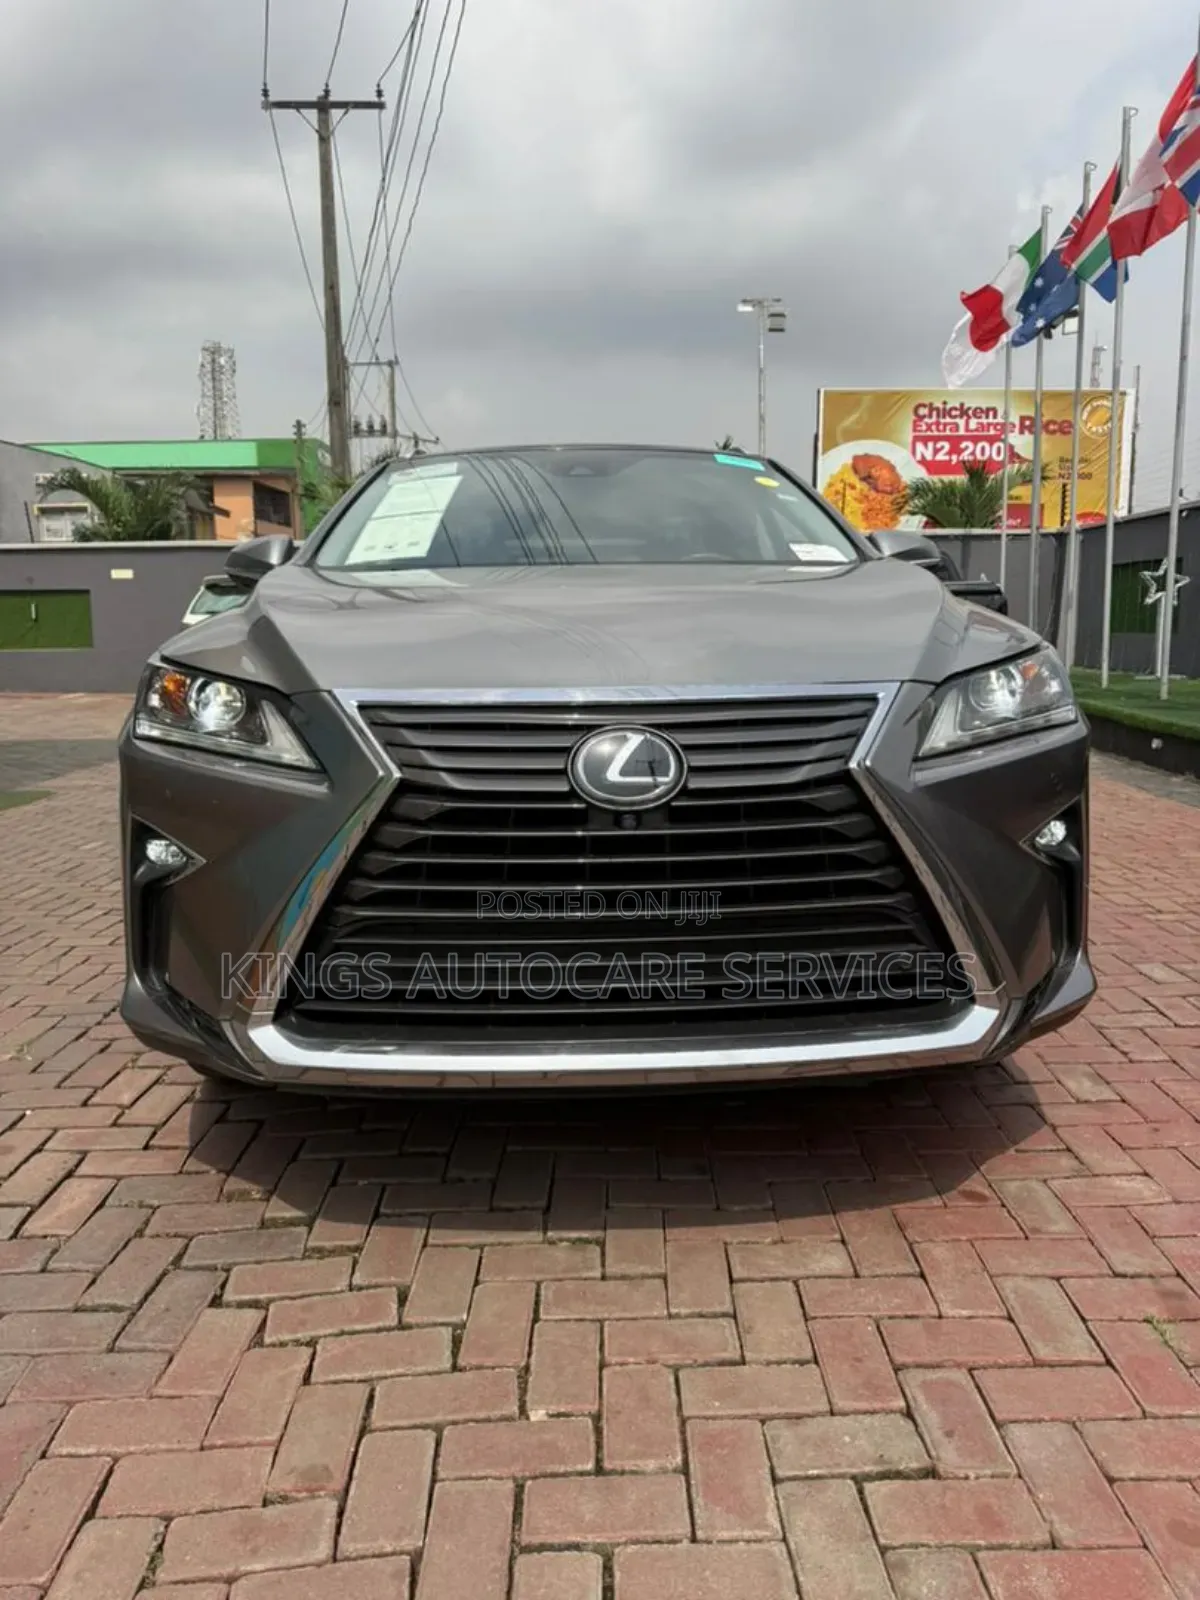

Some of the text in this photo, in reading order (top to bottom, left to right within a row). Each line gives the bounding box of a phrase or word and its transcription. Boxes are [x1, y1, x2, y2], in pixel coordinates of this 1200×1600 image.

[913, 401, 998, 421] Chicken
[913, 419, 960, 433] Extra
[1018, 415, 1074, 436] Rce
[915, 440, 1005, 464] N2,200
